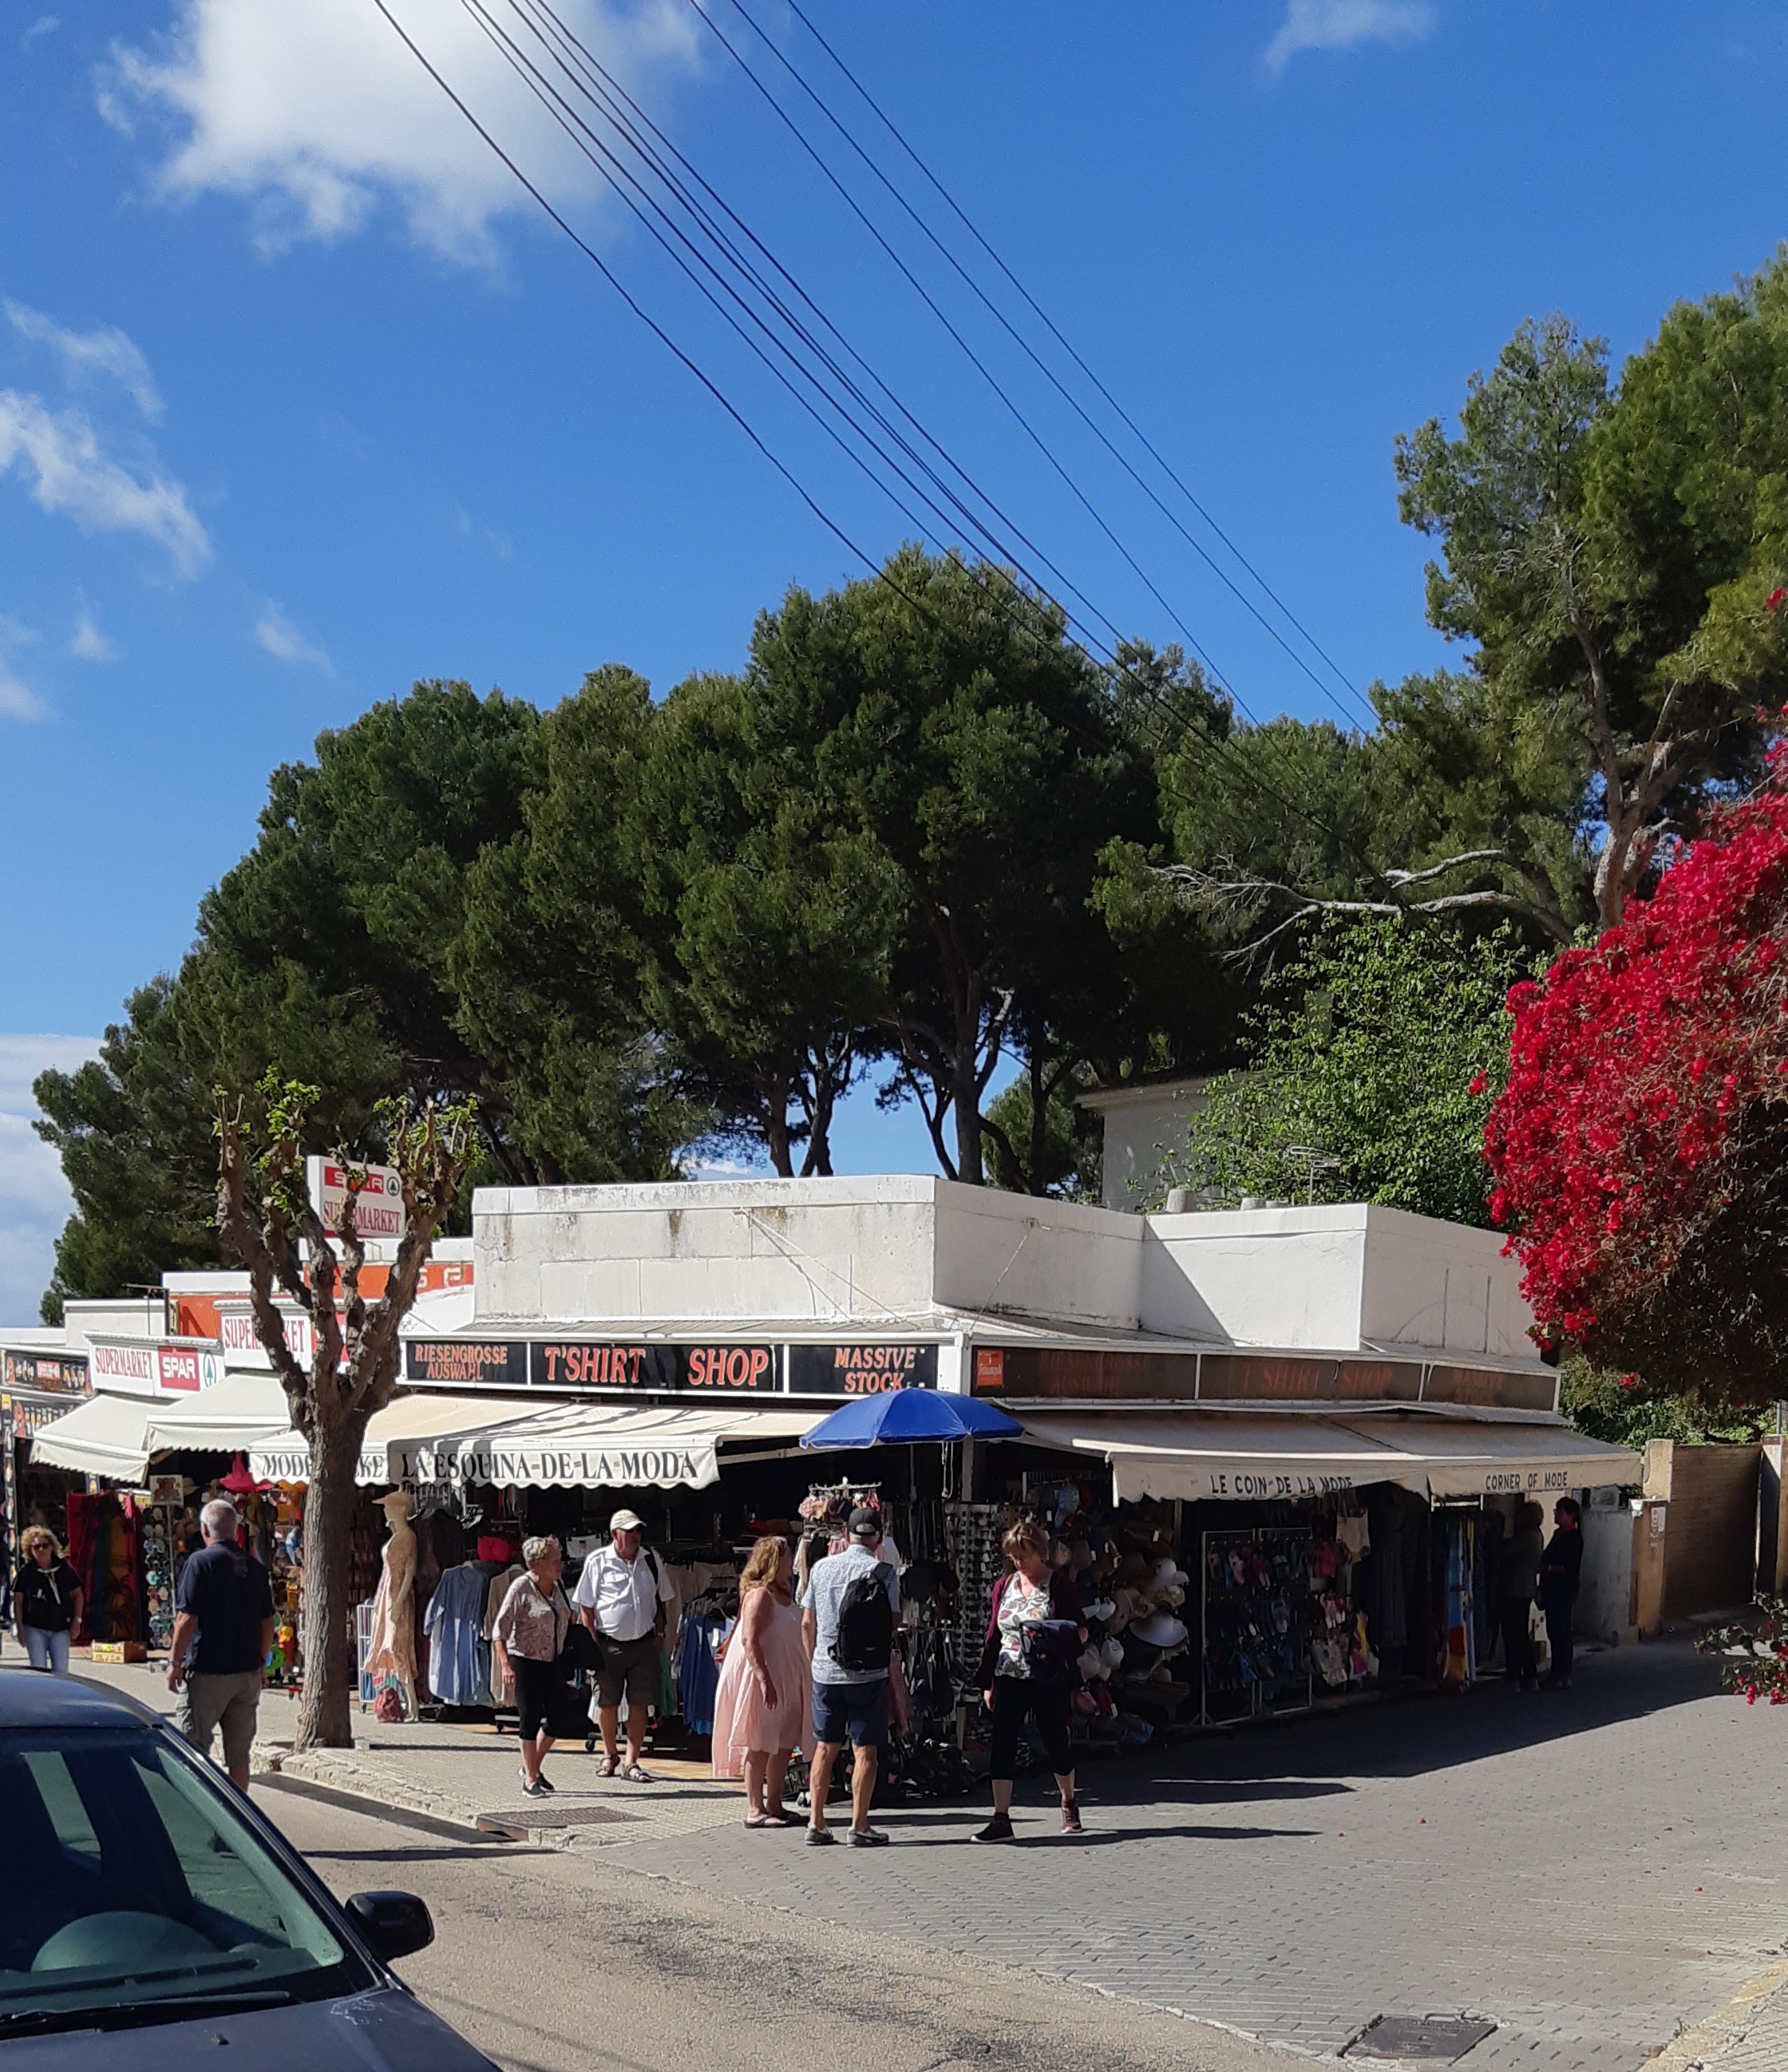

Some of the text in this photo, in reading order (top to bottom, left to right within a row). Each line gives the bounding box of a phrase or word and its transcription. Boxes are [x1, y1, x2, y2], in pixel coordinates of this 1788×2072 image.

[96, 1347, 196, 1380] SUPERMARKET SPAR
[415, 1344, 508, 1364] RIESENGROSSE
[834, 1347, 916, 1370] MASSIVE
[426, 1362, 483, 1380] AUSWAHL
[544, 1346, 769, 1386] T'SHIRT SHOP
[845, 1371, 904, 1393] STOCK
[619, 1451, 698, 1480] MODA
[1210, 1475, 1228, 1493] LE
[1235, 1476, 1268, 1495] COIN
[1276, 1477, 1292, 1493] DE
[1297, 1477, 1315, 1493] LA
[1485, 1471, 1568, 1491] CORNER OF MODE
